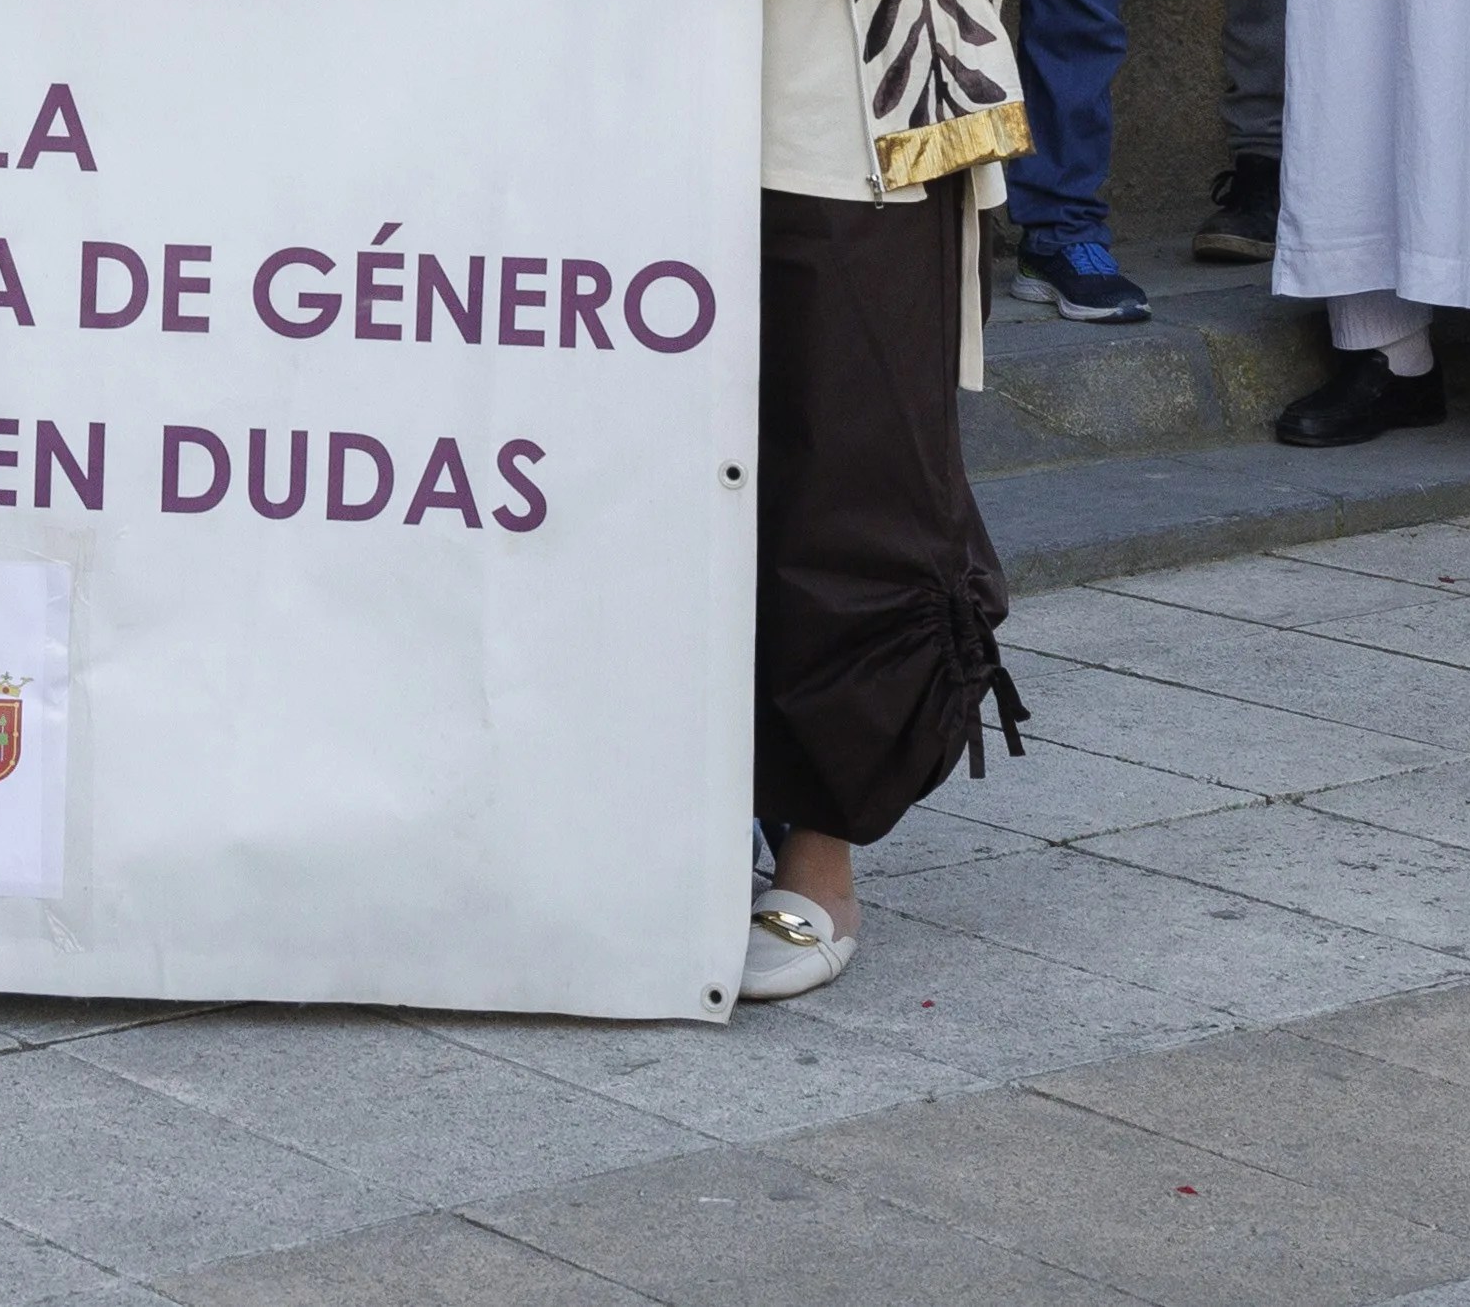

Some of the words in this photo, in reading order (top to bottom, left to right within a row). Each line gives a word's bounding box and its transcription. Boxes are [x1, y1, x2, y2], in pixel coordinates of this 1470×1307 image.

[79, 240, 212, 334] DE
[252, 223, 717, 354] GÉNERO
[160, 424, 547, 533] DUDAS
